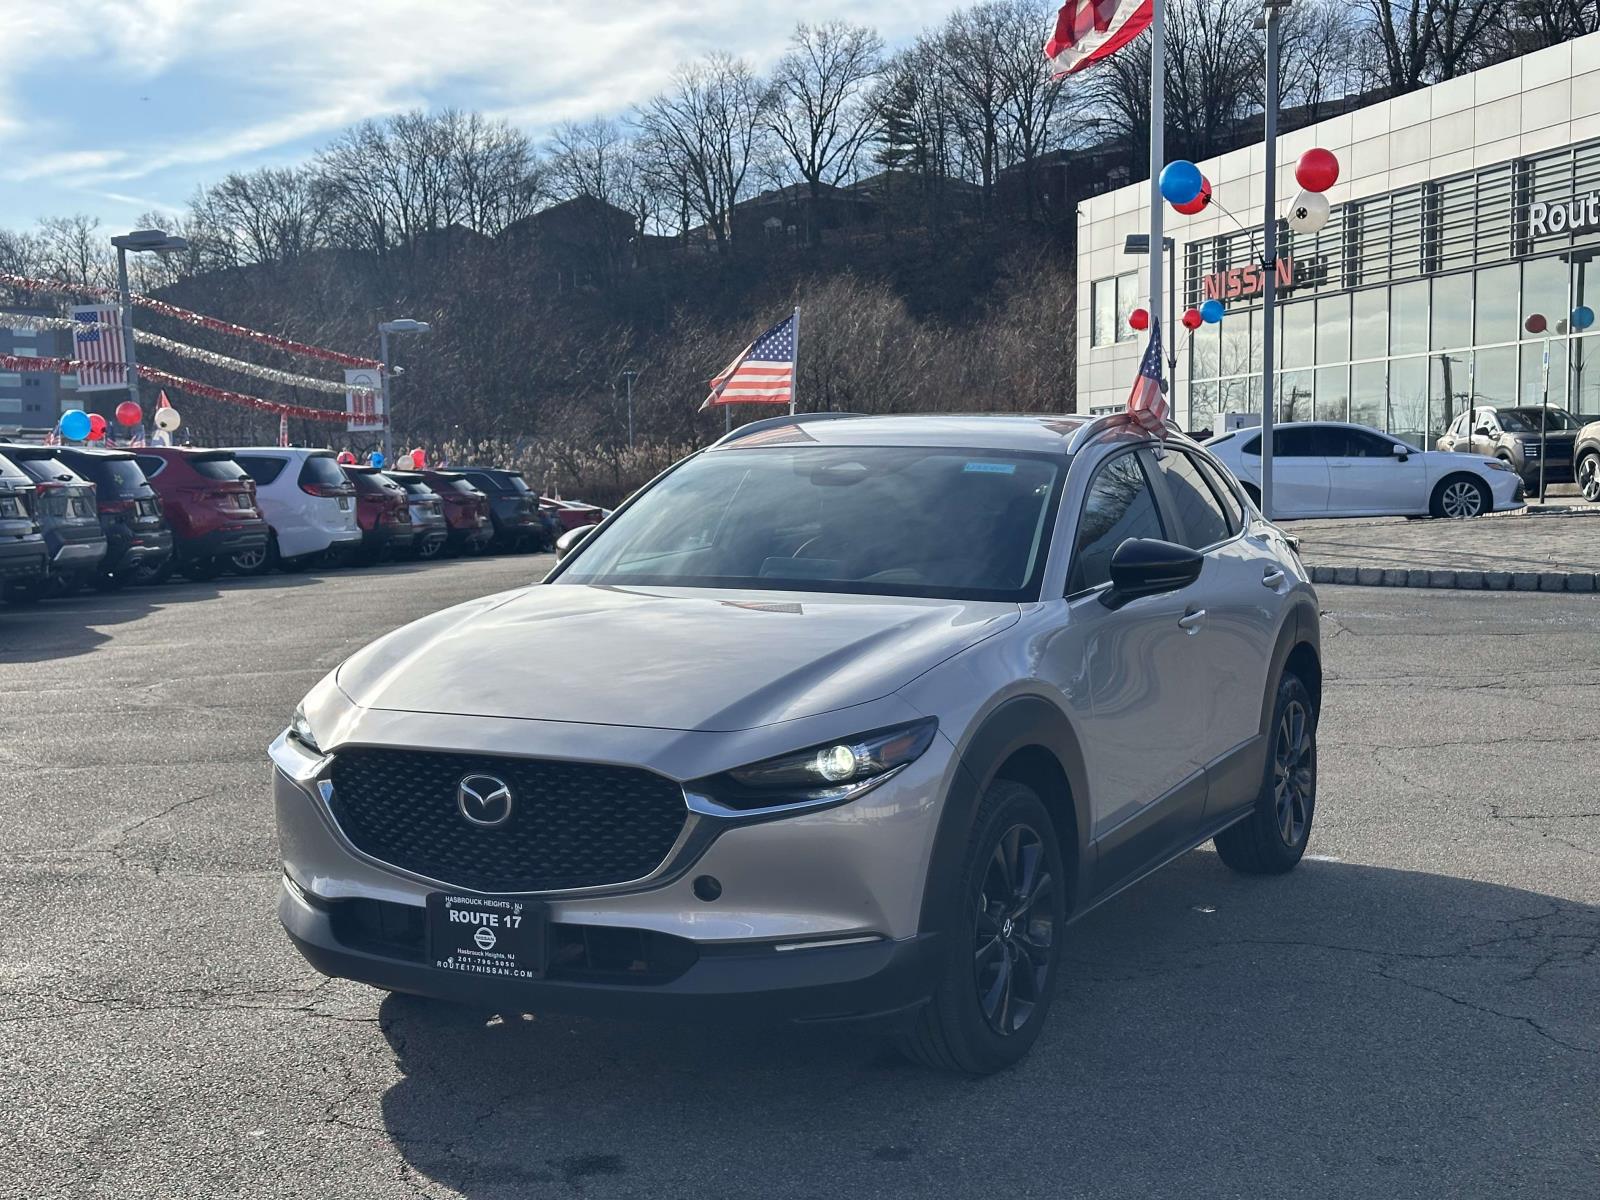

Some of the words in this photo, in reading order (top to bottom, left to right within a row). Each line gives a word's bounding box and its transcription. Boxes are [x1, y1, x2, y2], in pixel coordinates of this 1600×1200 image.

[445, 896, 482, 906] HASBROUCK
[449, 909, 499, 927] ROUTE
[503, 915, 521, 928] 17
[457, 948, 484, 957] Hasbrouck
[436, 961, 533, 978] ROUTE17NISSAN.COM
